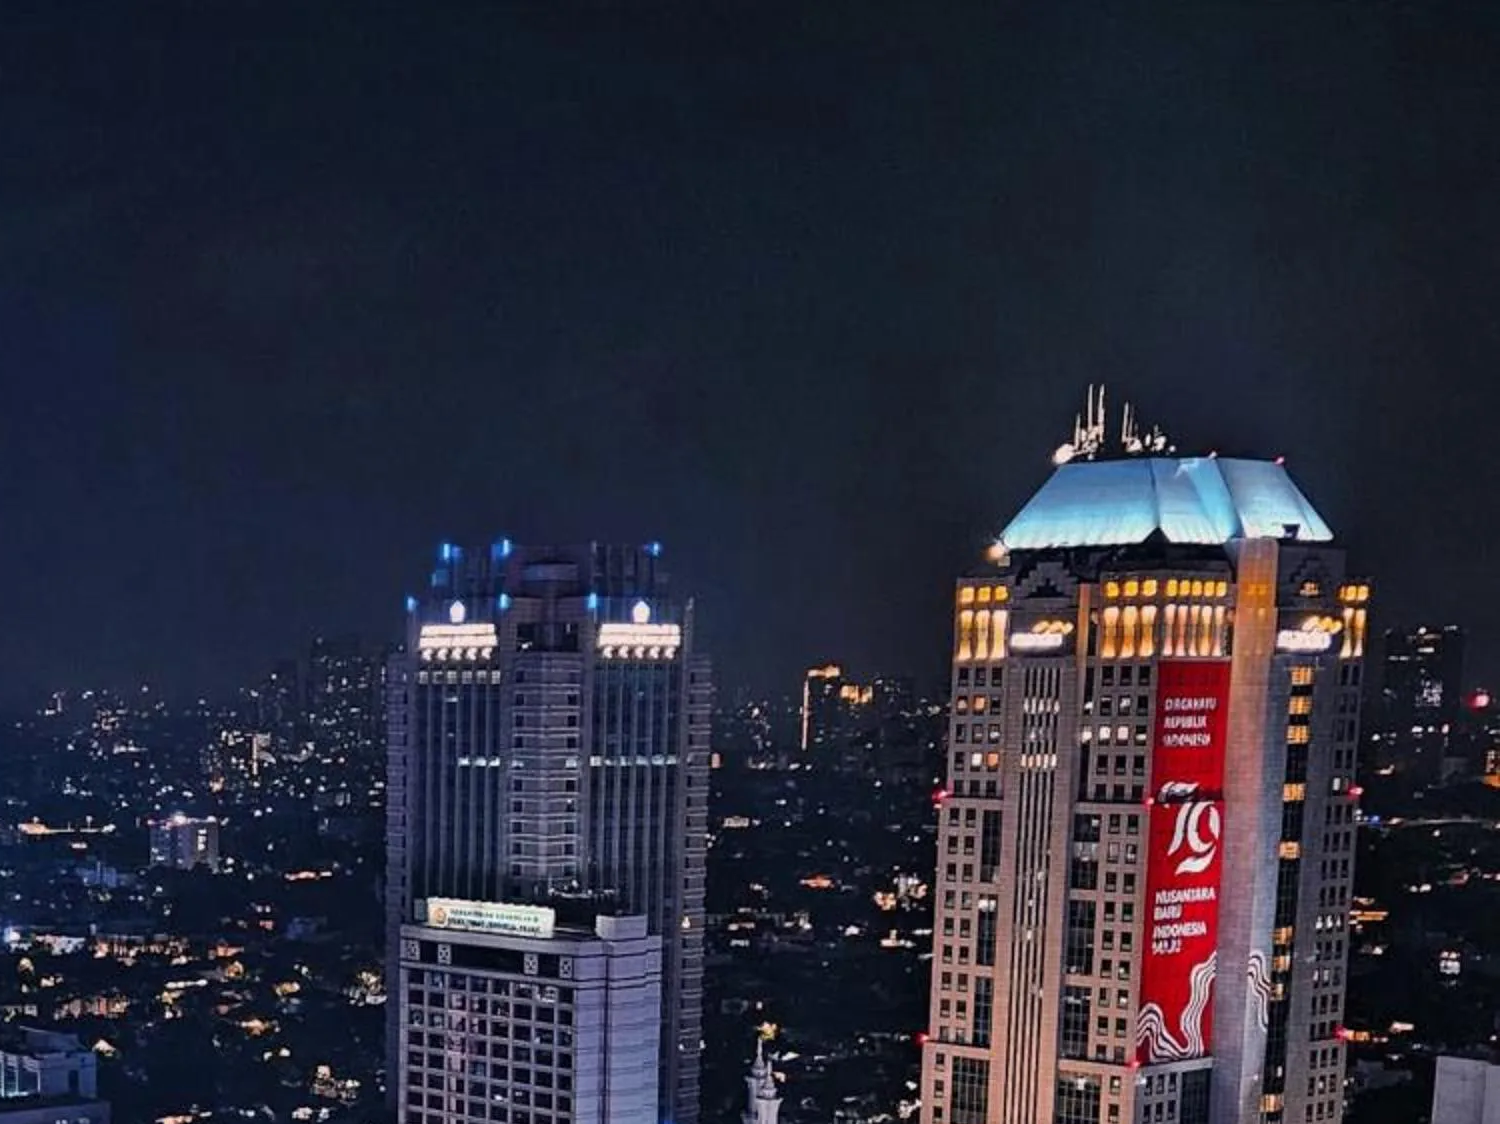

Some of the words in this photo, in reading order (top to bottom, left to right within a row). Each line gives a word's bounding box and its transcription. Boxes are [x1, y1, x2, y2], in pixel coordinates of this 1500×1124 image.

[1163, 732, 1211, 747] INDONESIA
[1155, 886, 1217, 905] NUSANTARA
[1153, 921, 1207, 938] INDONESIA
